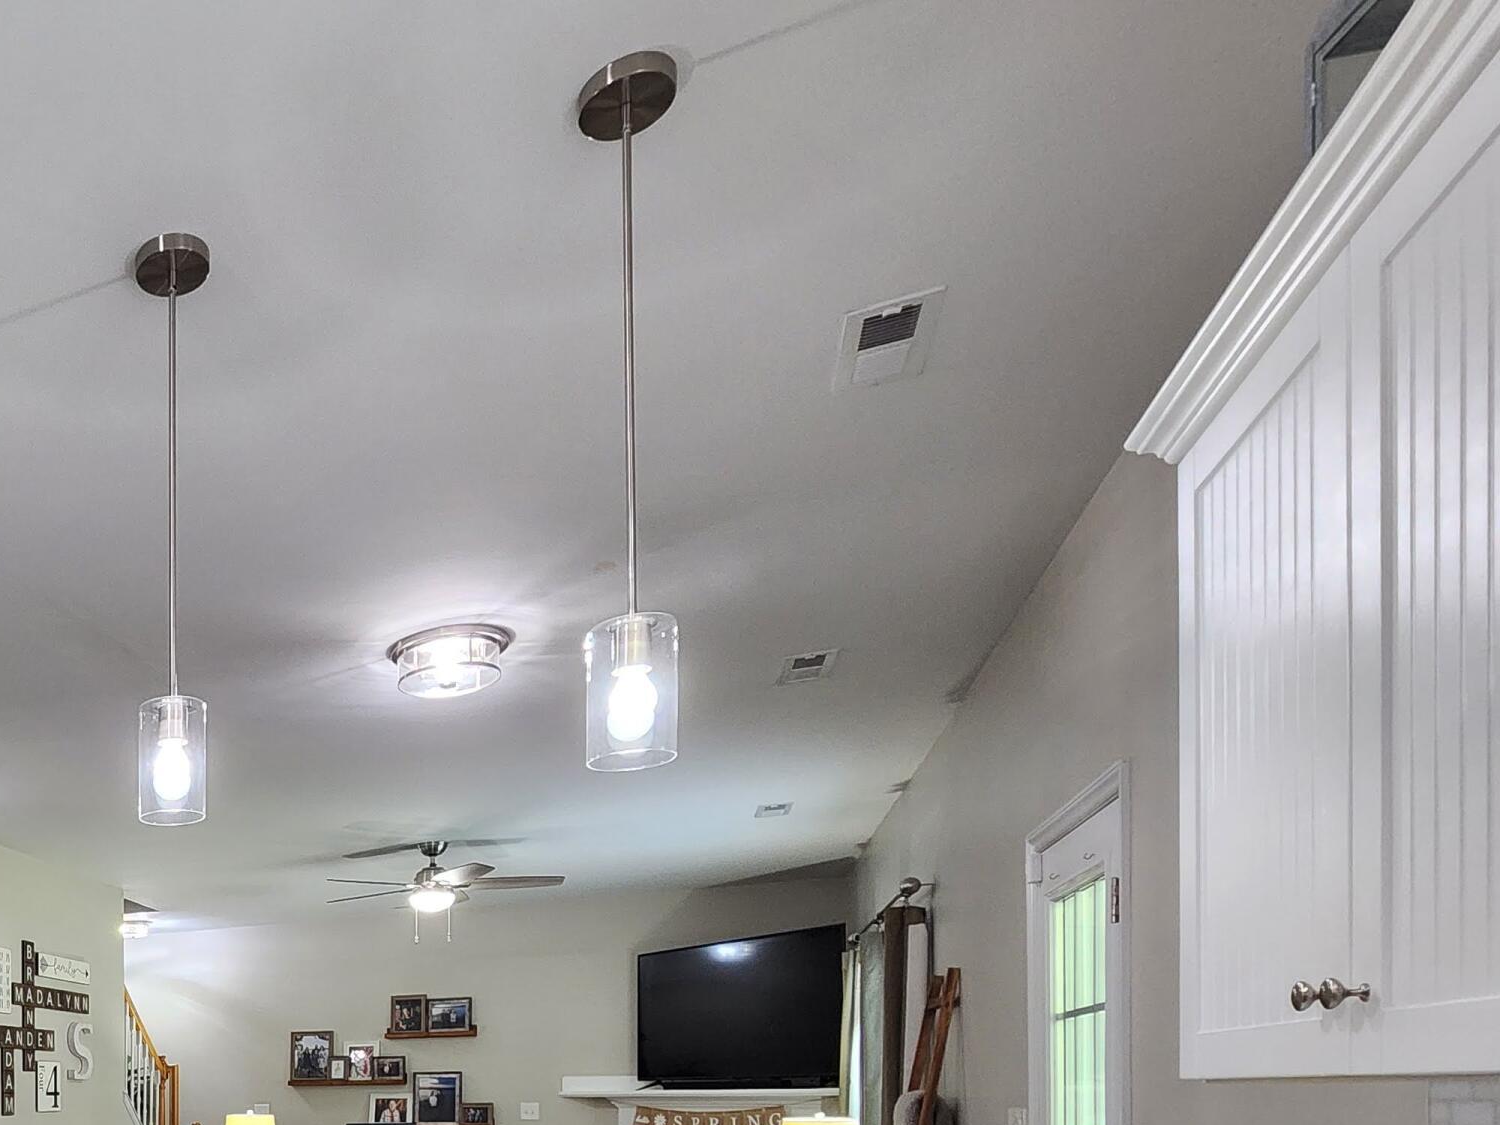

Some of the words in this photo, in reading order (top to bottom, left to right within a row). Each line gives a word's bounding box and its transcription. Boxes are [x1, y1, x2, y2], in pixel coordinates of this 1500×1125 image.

[14, 987, 89, 1012] MADALYNN
[25, 944, 34, 1068] BRANDY
[5, 1029, 14, 1114] ADAM
[66, 1020, 94, 1081] S
[46, 1065, 60, 1108] 4
